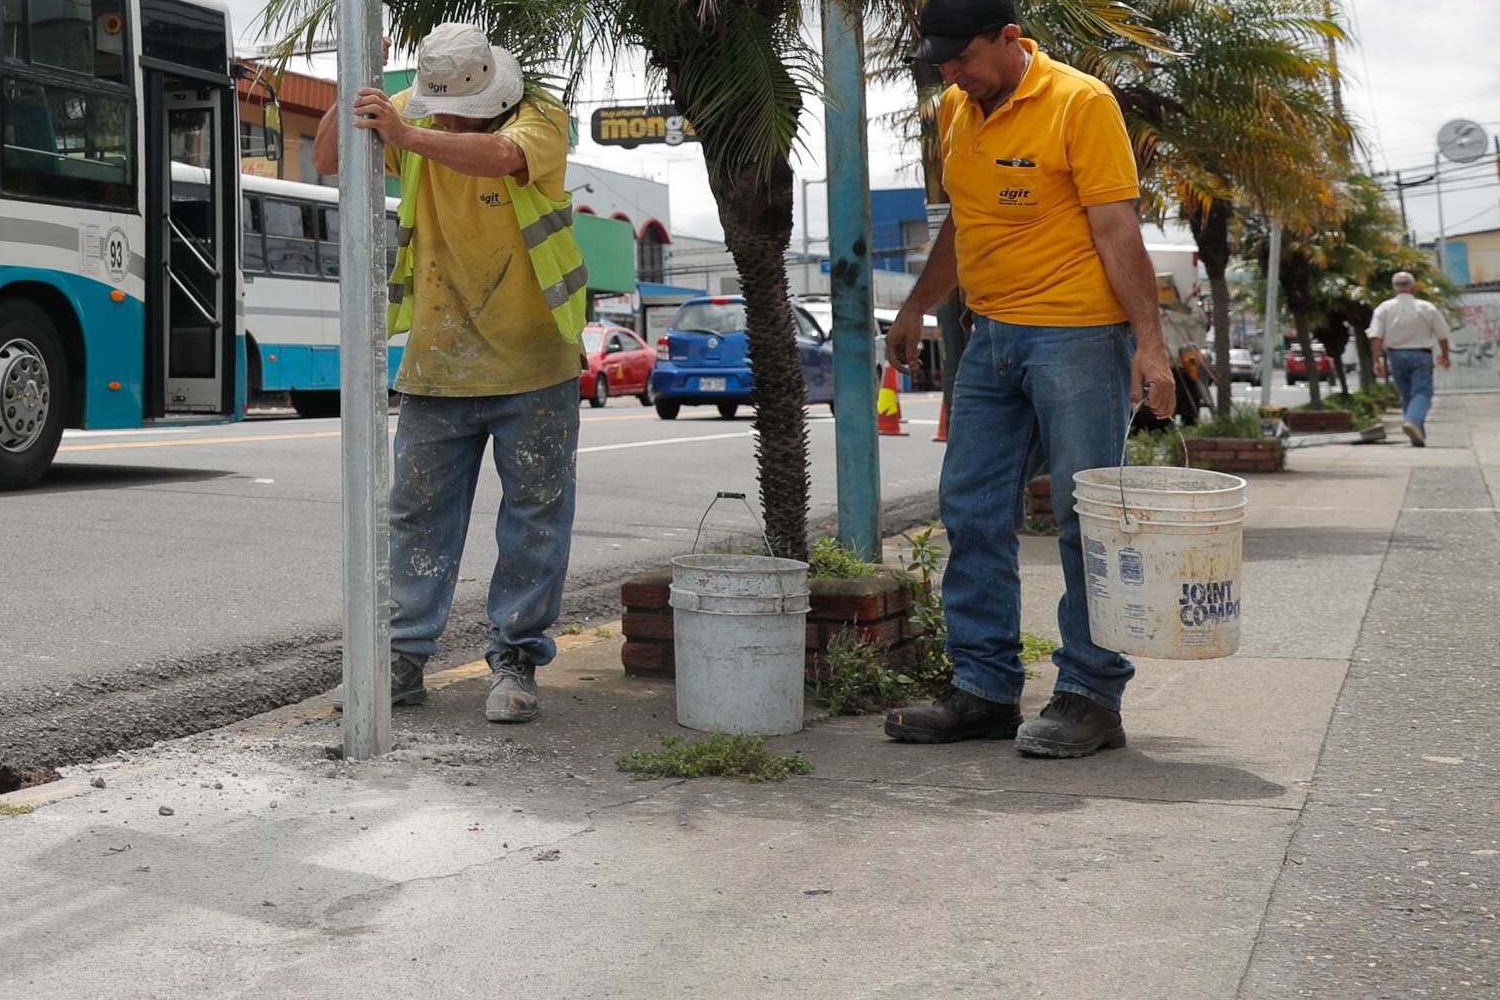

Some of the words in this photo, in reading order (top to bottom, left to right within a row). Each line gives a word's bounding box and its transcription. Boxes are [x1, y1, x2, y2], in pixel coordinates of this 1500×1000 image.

[999, 187, 1031, 199] dgit
[110, 240, 123, 268] 93
[1179, 580, 1232, 605] JOINT
